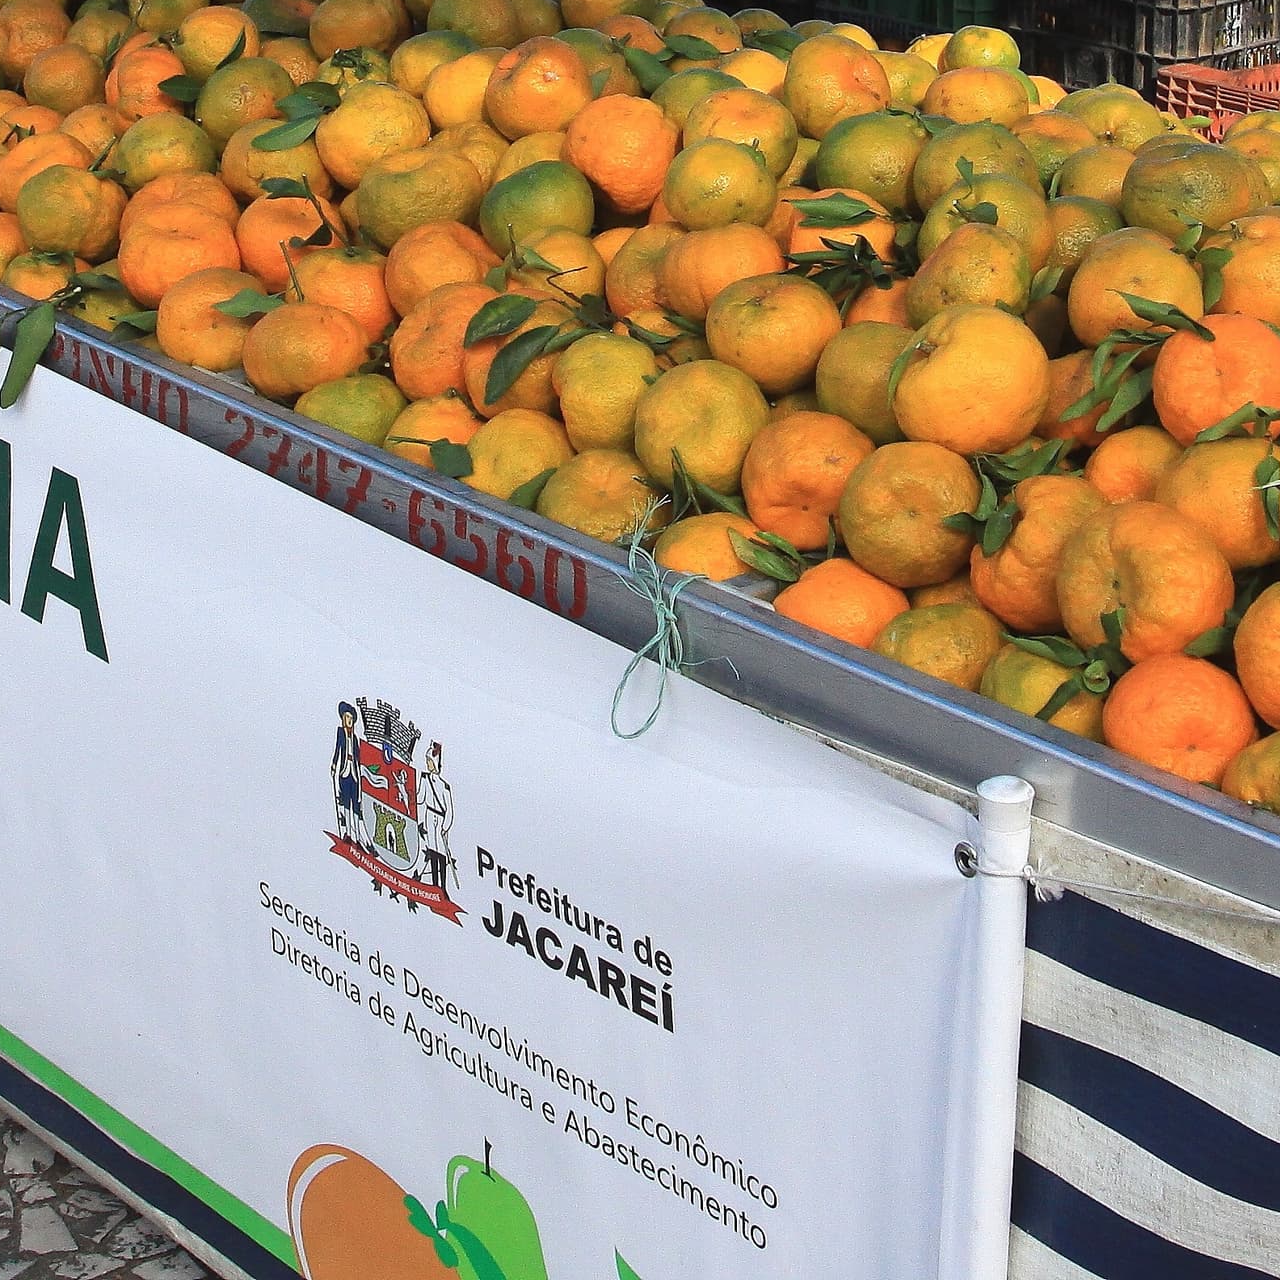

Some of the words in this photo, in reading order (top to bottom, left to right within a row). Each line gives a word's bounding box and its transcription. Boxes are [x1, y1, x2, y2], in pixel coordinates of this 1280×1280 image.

[477, 845, 623, 953] Prefeitura
[633, 935, 672, 976] de
[482, 899, 674, 1033] JACAREÍ
[259, 881, 361, 965] Secretaria
[369, 951, 395, 985] de
[403, 967, 615, 1114] Desenvolvimento
[625, 1097, 777, 1209] Econômico
[271, 927, 361, 1005] Diretoria
[369, 991, 395, 1026] de
[403, 1012, 533, 1111] Agricultura
[542, 1101, 555, 1123] e
[565, 1110, 766, 1249] Abastecimento
